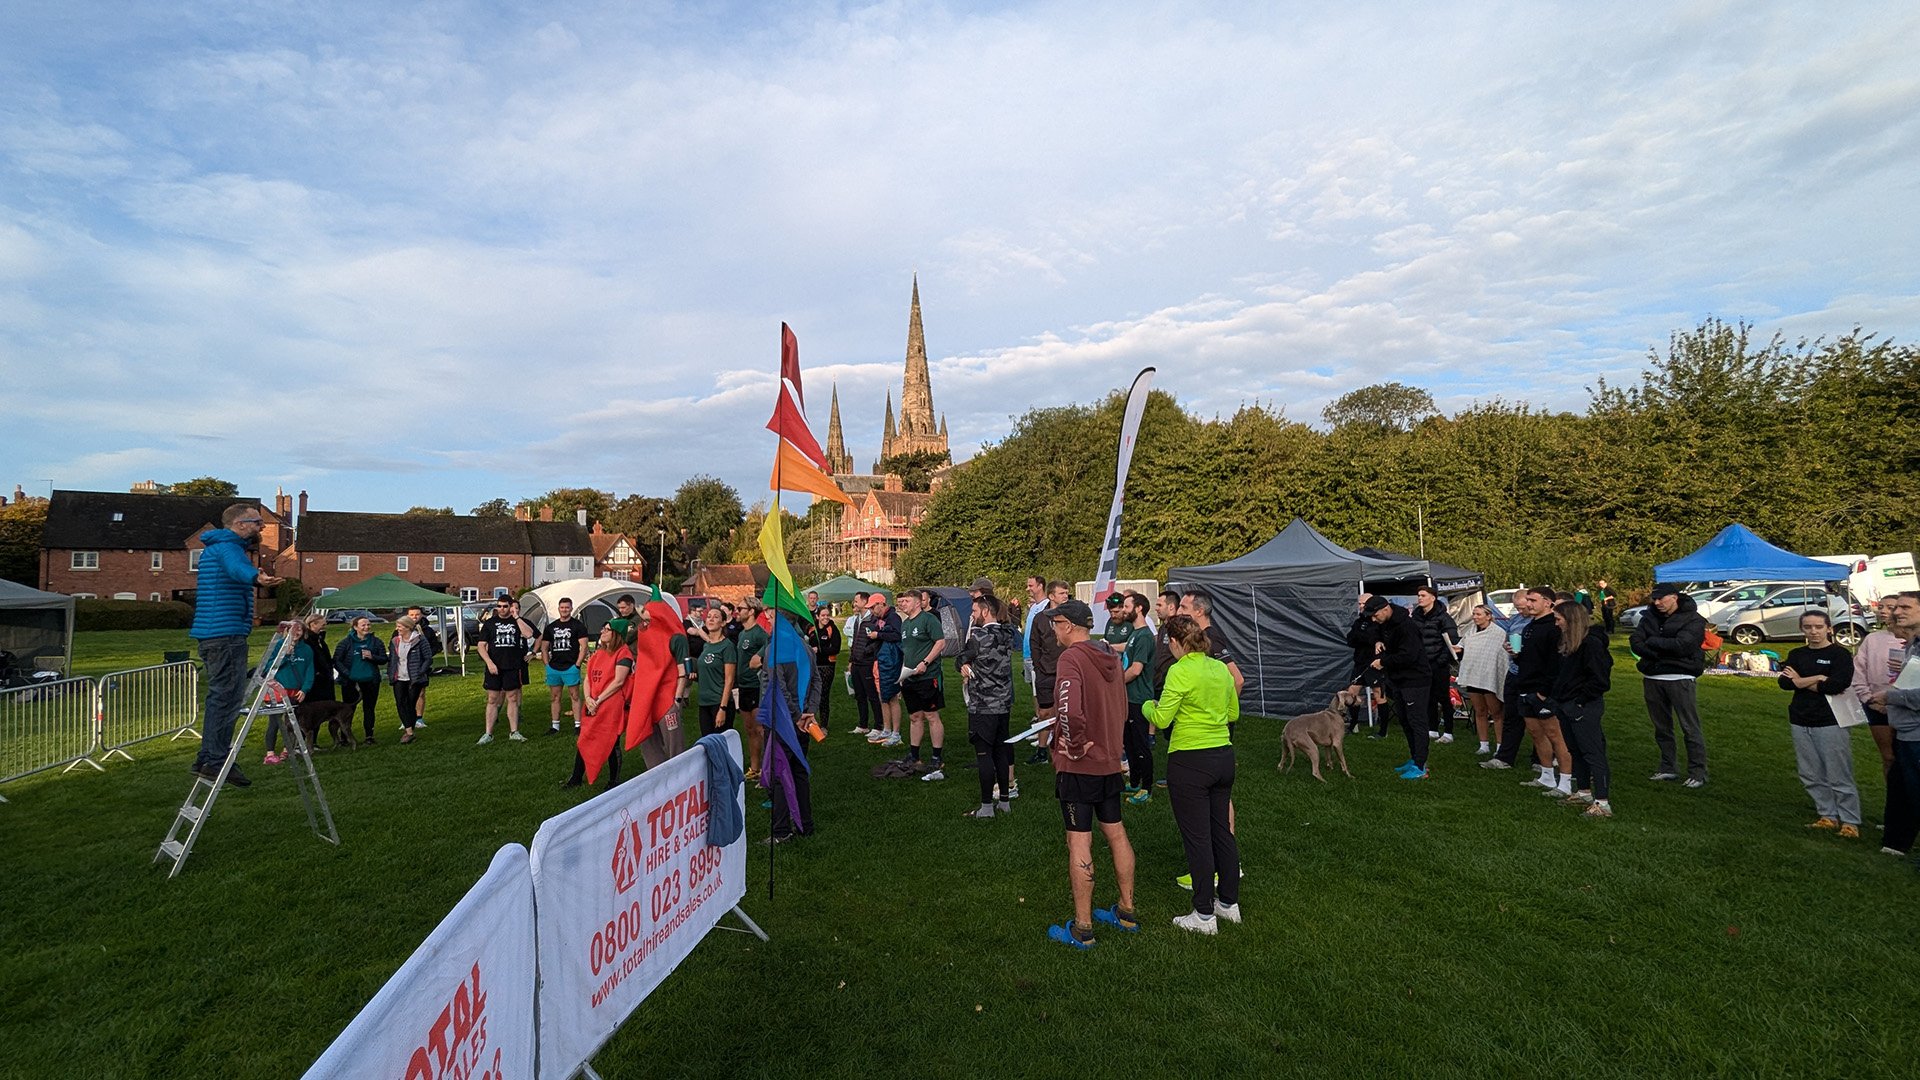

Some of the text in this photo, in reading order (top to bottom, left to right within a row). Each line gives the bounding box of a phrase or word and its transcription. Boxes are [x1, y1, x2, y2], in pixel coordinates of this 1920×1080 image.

[646, 817, 710, 874] HIRE & SALES
[647, 780, 710, 848] TOTAL
[590, 843, 722, 977] 0800 023 8993
[592, 872, 722, 1009] www.totalhireandsales.co.uk
